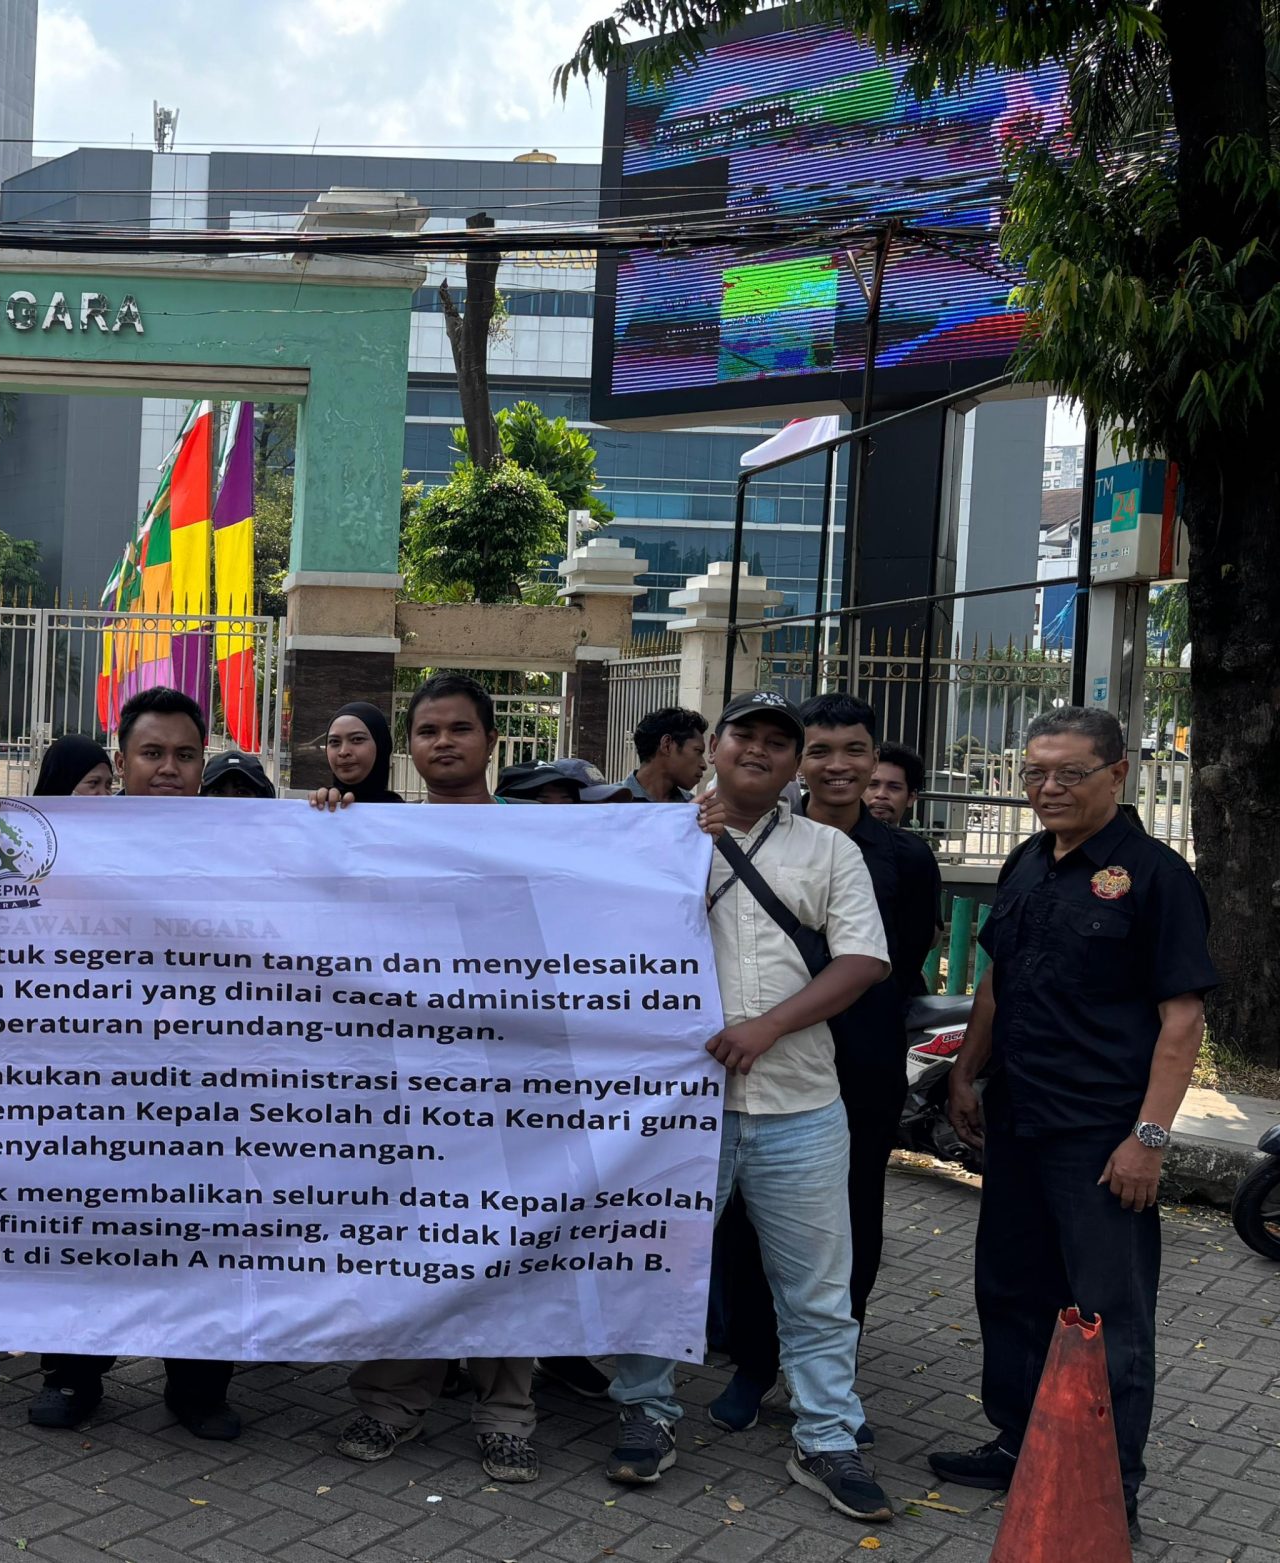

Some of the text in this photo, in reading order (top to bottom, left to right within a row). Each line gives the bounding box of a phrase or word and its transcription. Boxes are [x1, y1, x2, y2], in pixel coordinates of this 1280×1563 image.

[1095, 475, 1114, 497] TM
[1113, 489, 1136, 521] 24
[153, 918, 281, 938] NEGARA
[54, 949, 154, 971] segera
[163, 948, 252, 969] turun
[261, 952, 372, 978] tangan
[382, 952, 441, 974] dan
[452, 953, 699, 980] menyelesaikan
[15, 978, 132, 1000] Kendari
[141, 984, 217, 1006] yang
[224, 980, 322, 1003] dinilai
[332, 990, 418, 1009] cacat
[427, 988, 631, 1011] administrasi
[641, 989, 701, 1011] dan
[153, 1015, 505, 1045] perundang-undangan.
[110, 1066, 192, 1087] audit
[200, 1067, 398, 1091] administrasi
[407, 1075, 512, 1094] secara
[523, 1075, 720, 1101] menyeluruh
[136, 1101, 239, 1127] Kepala
[249, 1102, 373, 1125] Sekolah
[382, 1104, 411, 1125] di
[422, 1106, 494, 1128] Kota
[505, 1108, 630, 1131] Kendari
[640, 1114, 718, 1138] guna
[235, 1136, 445, 1165] kewenangan.
[17, 1182, 263, 1209] mengembalikan
[272, 1184, 389, 1206] seluruh
[399, 1186, 469, 1209] data
[481, 1190, 586, 1218] Kepala
[593, 1187, 715, 1213] Sekolah
[91, 1217, 329, 1244] masing-masing,
[339, 1223, 409, 1246] agar
[417, 1222, 501, 1246] tidak
[510, 1225, 562, 1250] lagi
[568, 1219, 667, 1244] terjadi
[23, 1245, 51, 1265] di
[59, 1247, 179, 1268] Sekolah
[187, 1249, 209, 1269] A
[218, 1253, 326, 1273] namun
[337, 1253, 476, 1285] bertugas
[484, 1259, 512, 1280] di
[518, 1251, 634, 1276] Sekolah
[644, 1253, 672, 1273] B.
